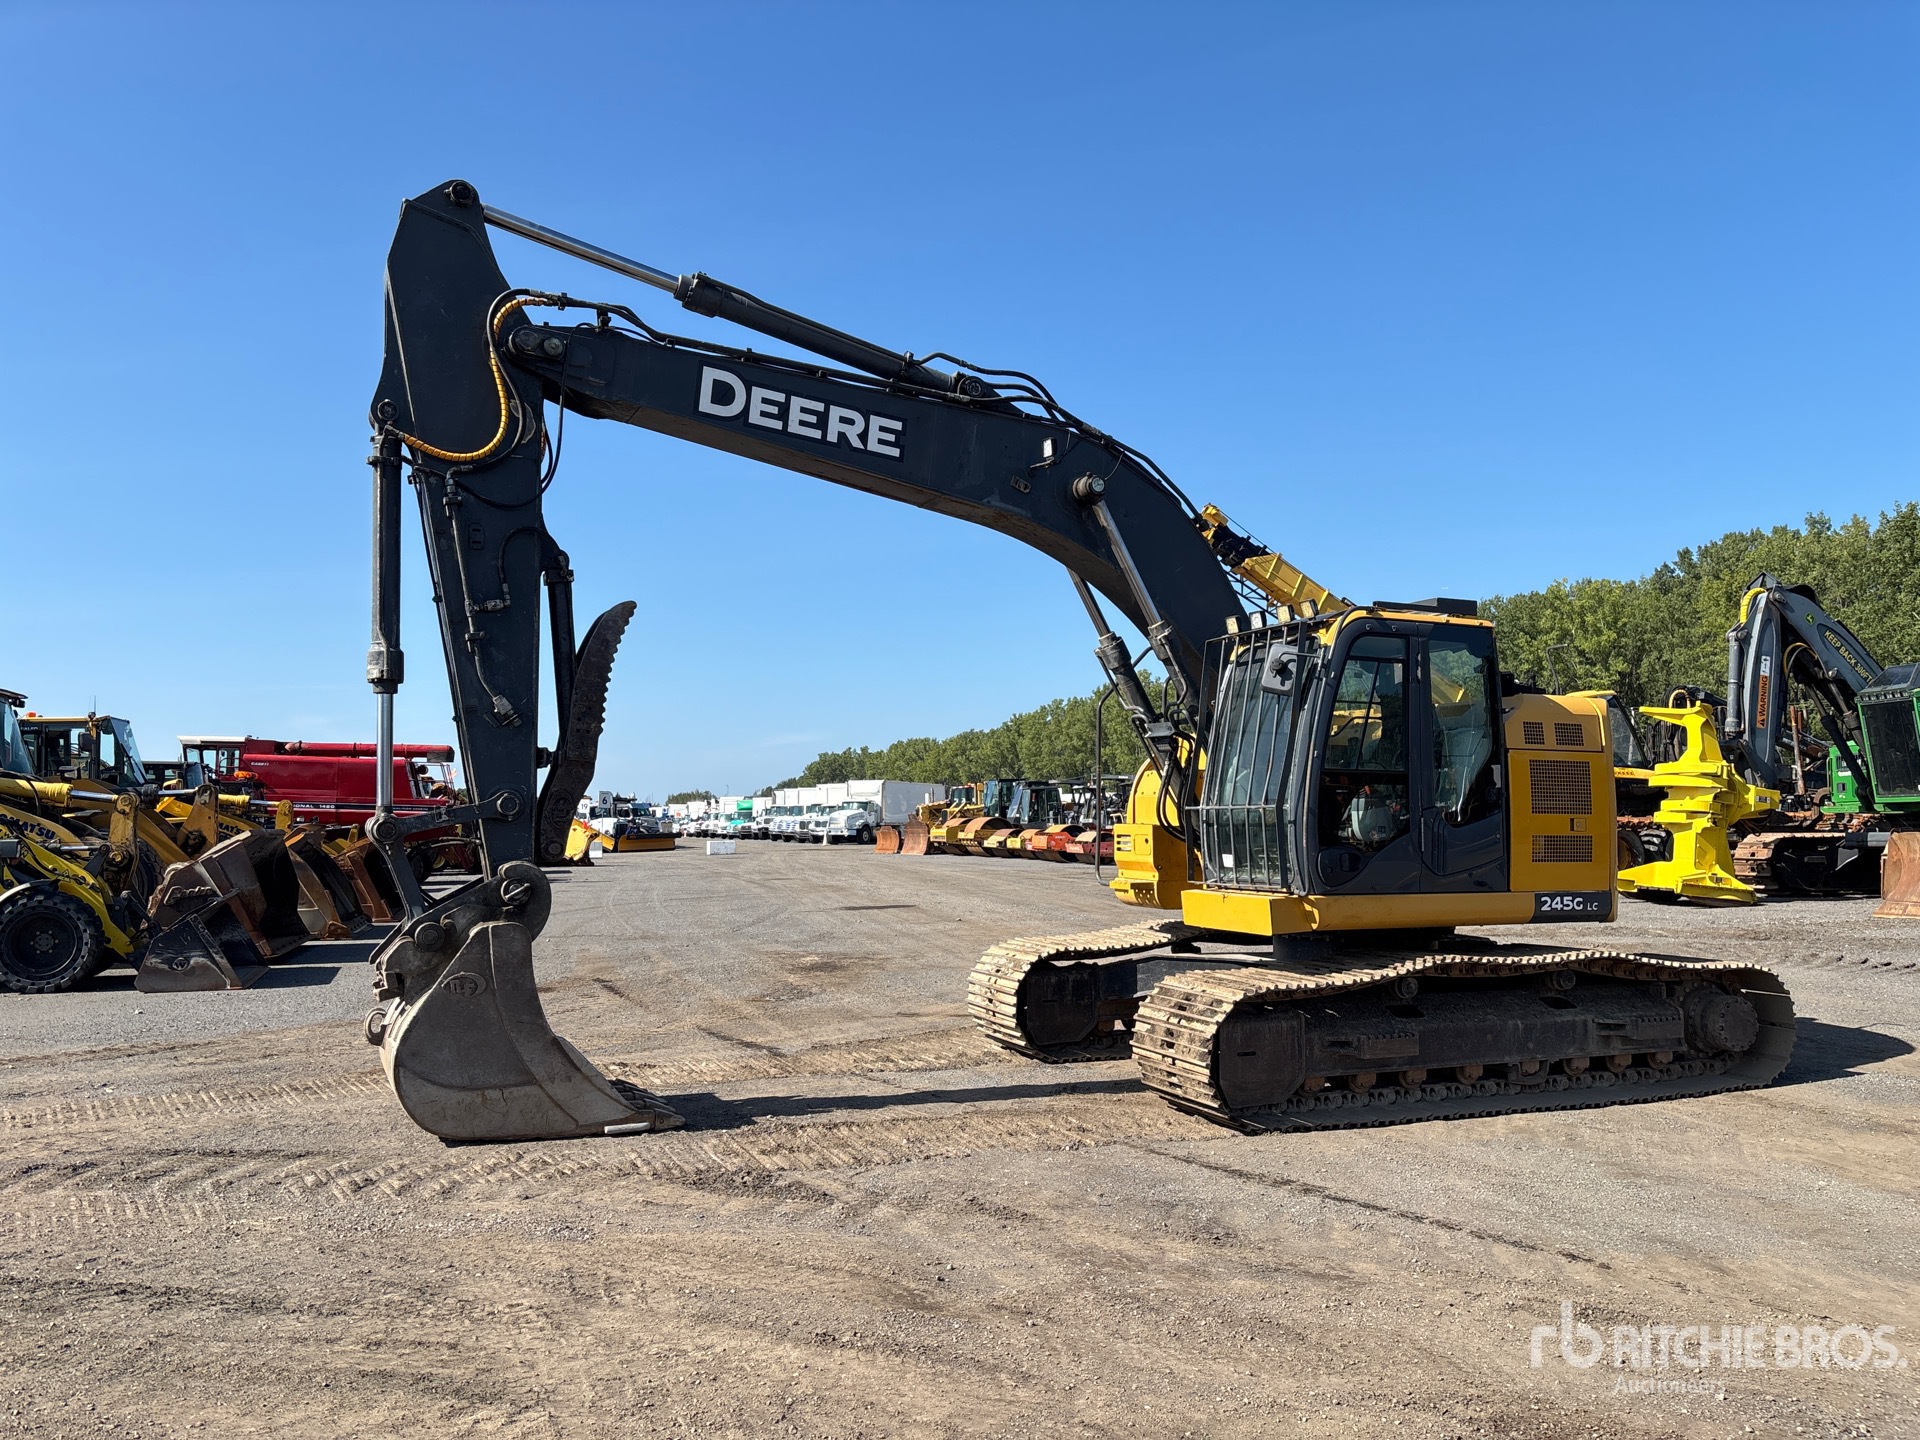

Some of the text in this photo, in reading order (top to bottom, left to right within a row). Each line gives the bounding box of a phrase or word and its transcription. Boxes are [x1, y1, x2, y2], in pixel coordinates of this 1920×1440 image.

[698, 365, 903, 458] DEERE
[1824, 629, 1873, 683] KEEP BACK 300FT
[1758, 676, 1768, 717] WARNING
[602, 796, 608, 805] 6
[1540, 896, 1598, 911] 245G LC
